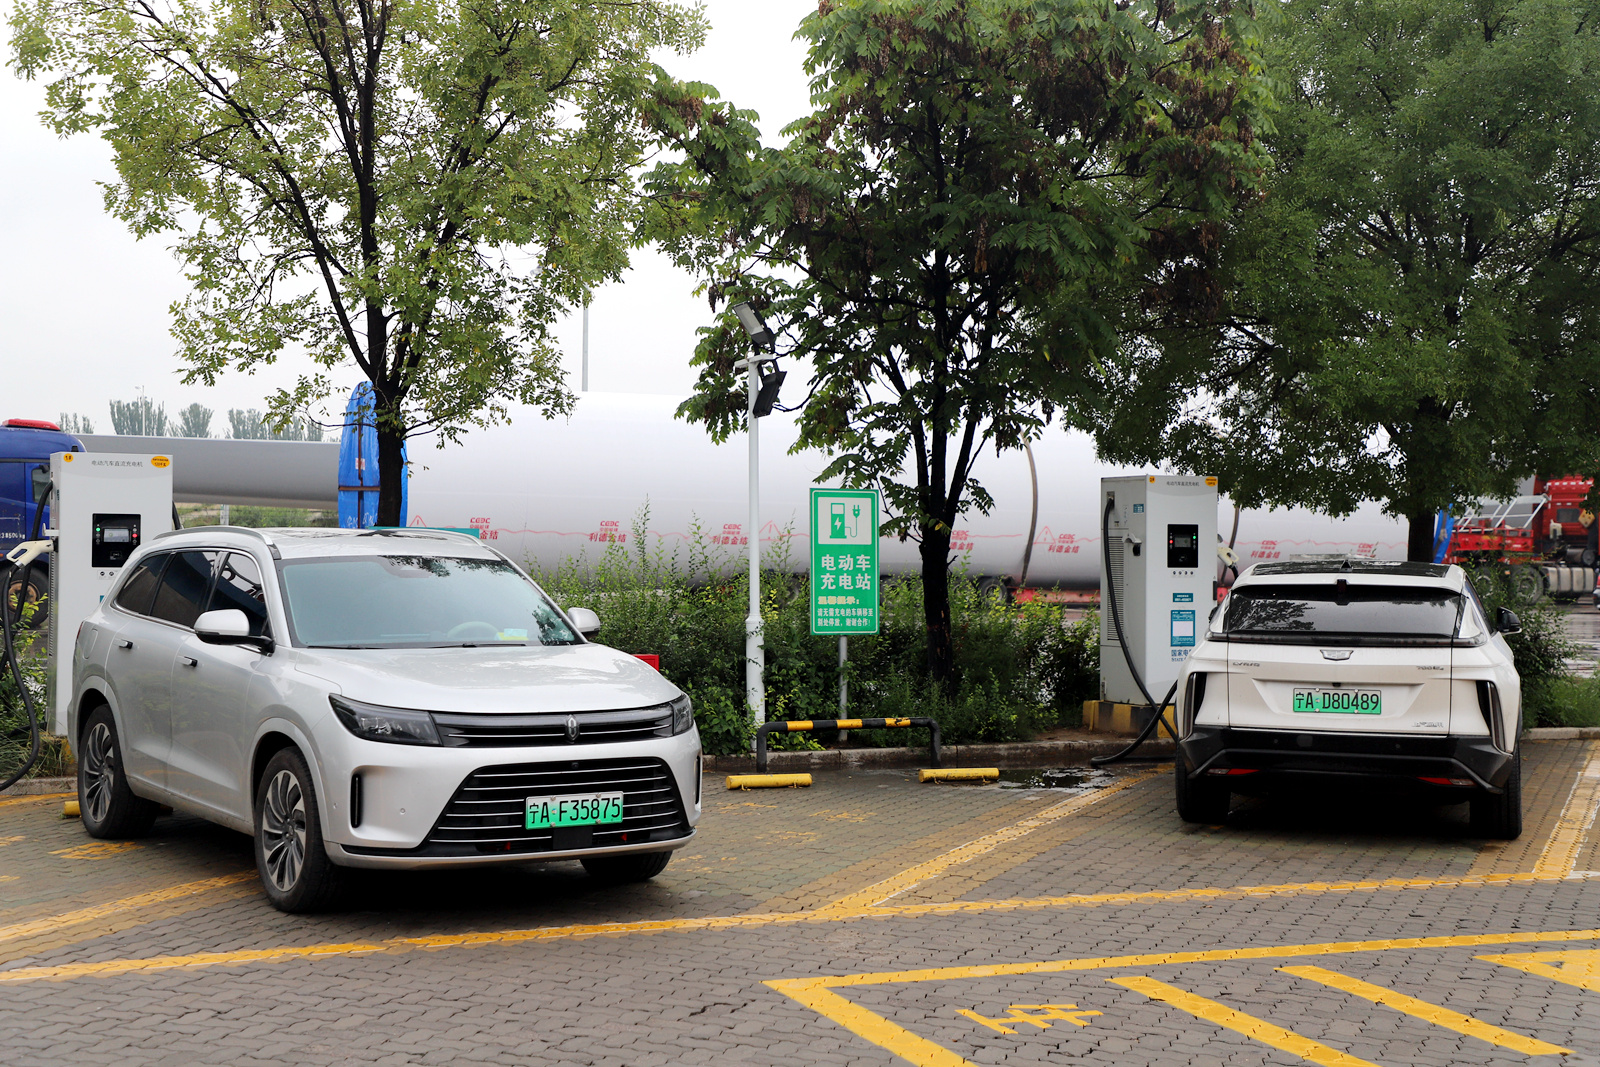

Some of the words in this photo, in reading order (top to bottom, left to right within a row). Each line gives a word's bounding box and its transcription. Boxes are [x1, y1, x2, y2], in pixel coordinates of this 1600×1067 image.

[479, 530, 499, 540] 金结
[949, 541, 974, 551] 德金结
[821, 554, 871, 571] 电动车
[820, 573, 871, 590] 充电站
[1171, 649, 1191, 657] 国家电
